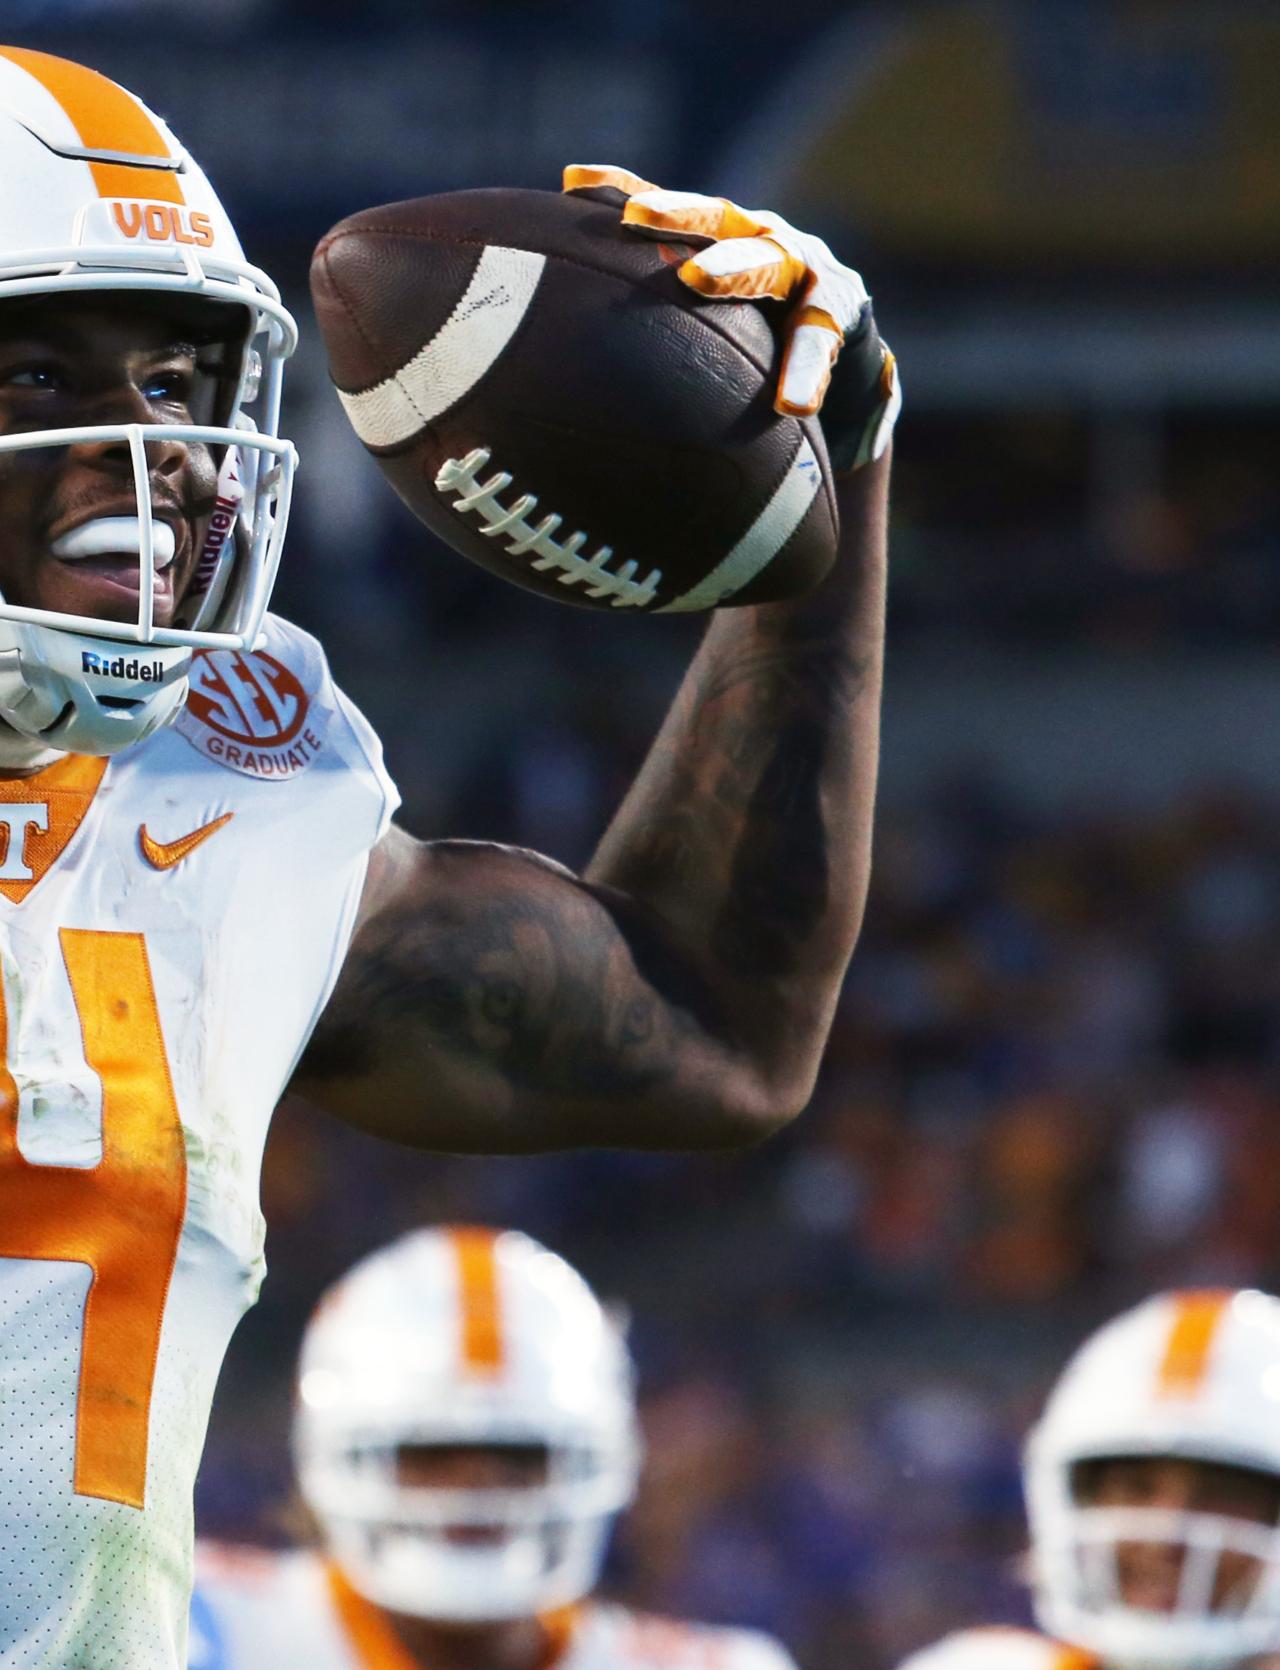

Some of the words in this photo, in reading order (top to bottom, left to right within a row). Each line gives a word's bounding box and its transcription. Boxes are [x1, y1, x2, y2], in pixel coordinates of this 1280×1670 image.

[113, 203, 214, 248] VOLS
[81, 651, 163, 682] Riddell
[191, 651, 299, 737] SEC
[207, 728, 322, 775] GRADUATE
